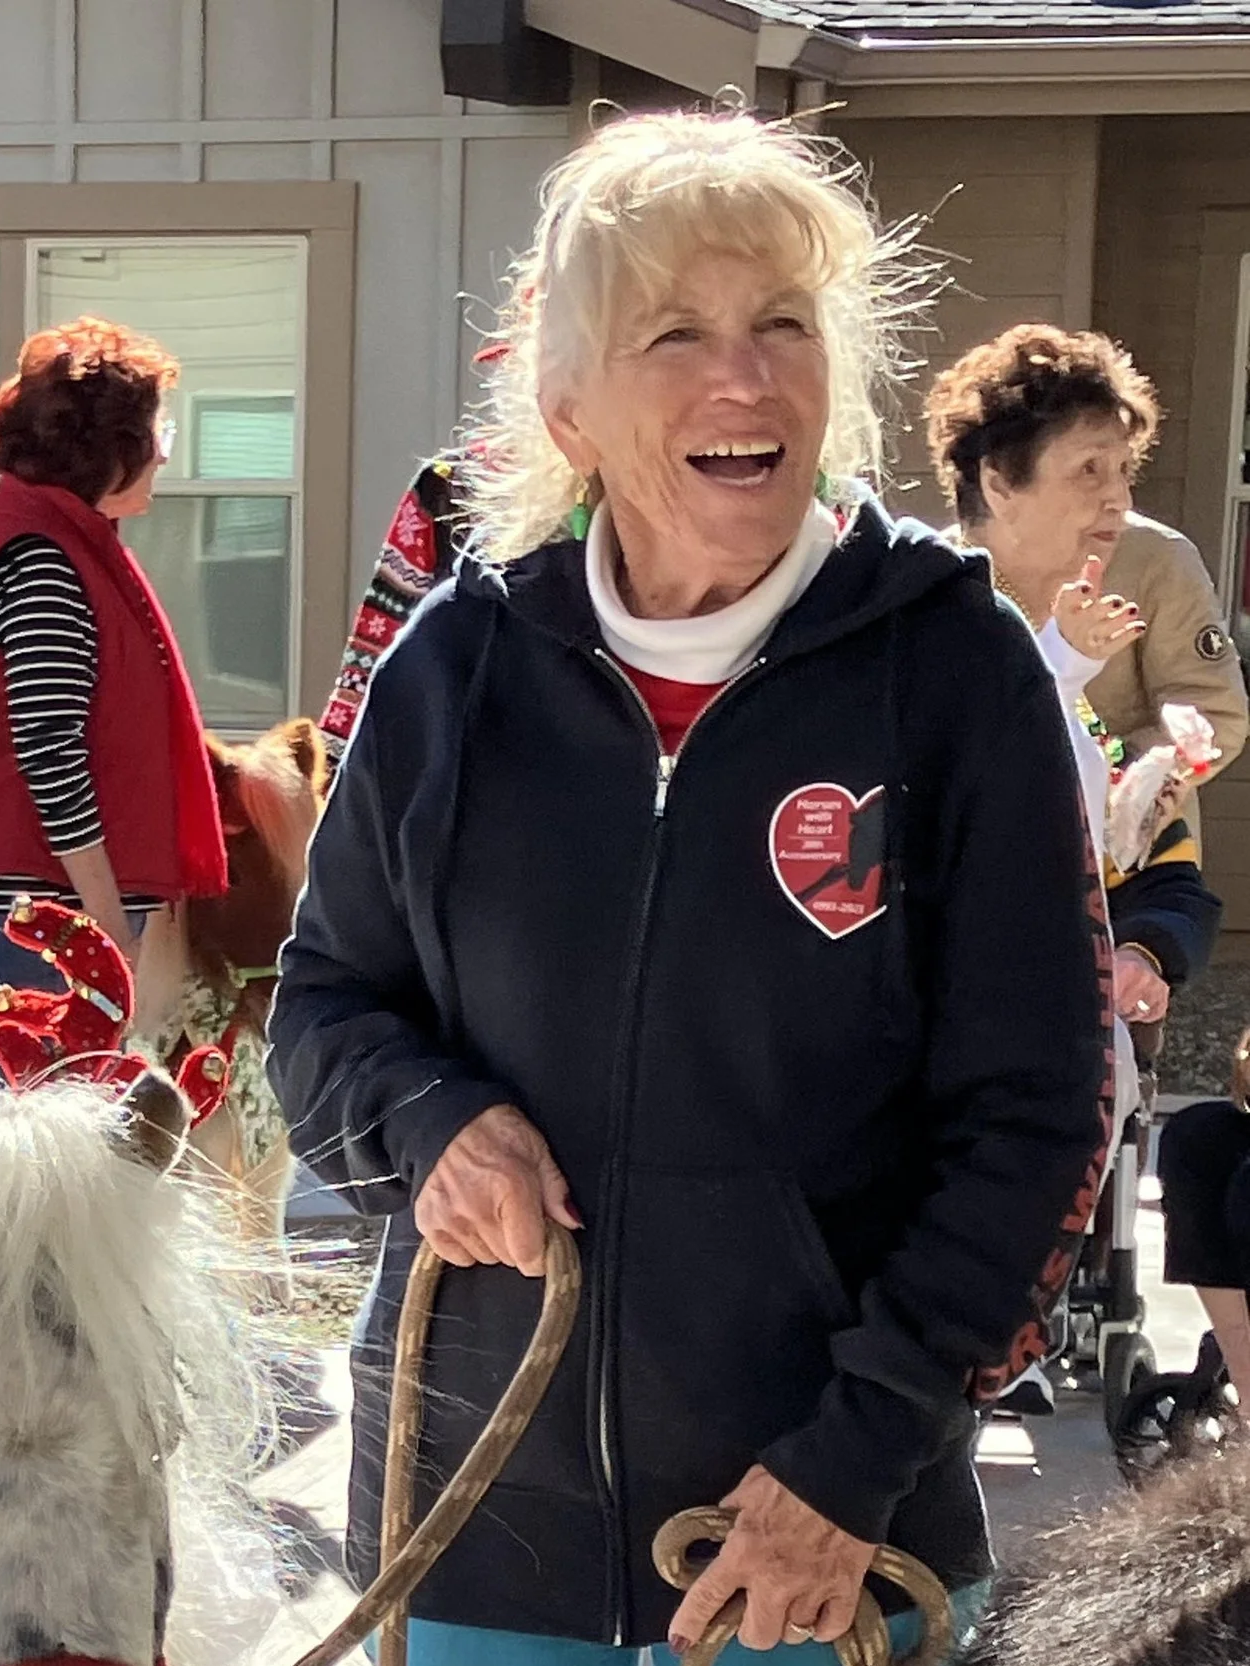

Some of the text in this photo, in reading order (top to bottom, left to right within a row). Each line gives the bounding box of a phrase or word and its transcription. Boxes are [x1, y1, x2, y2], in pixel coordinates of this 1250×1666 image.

[797, 799, 843, 811] Horses
[805, 811, 833, 822] with
[797, 823, 833, 835] Heart
